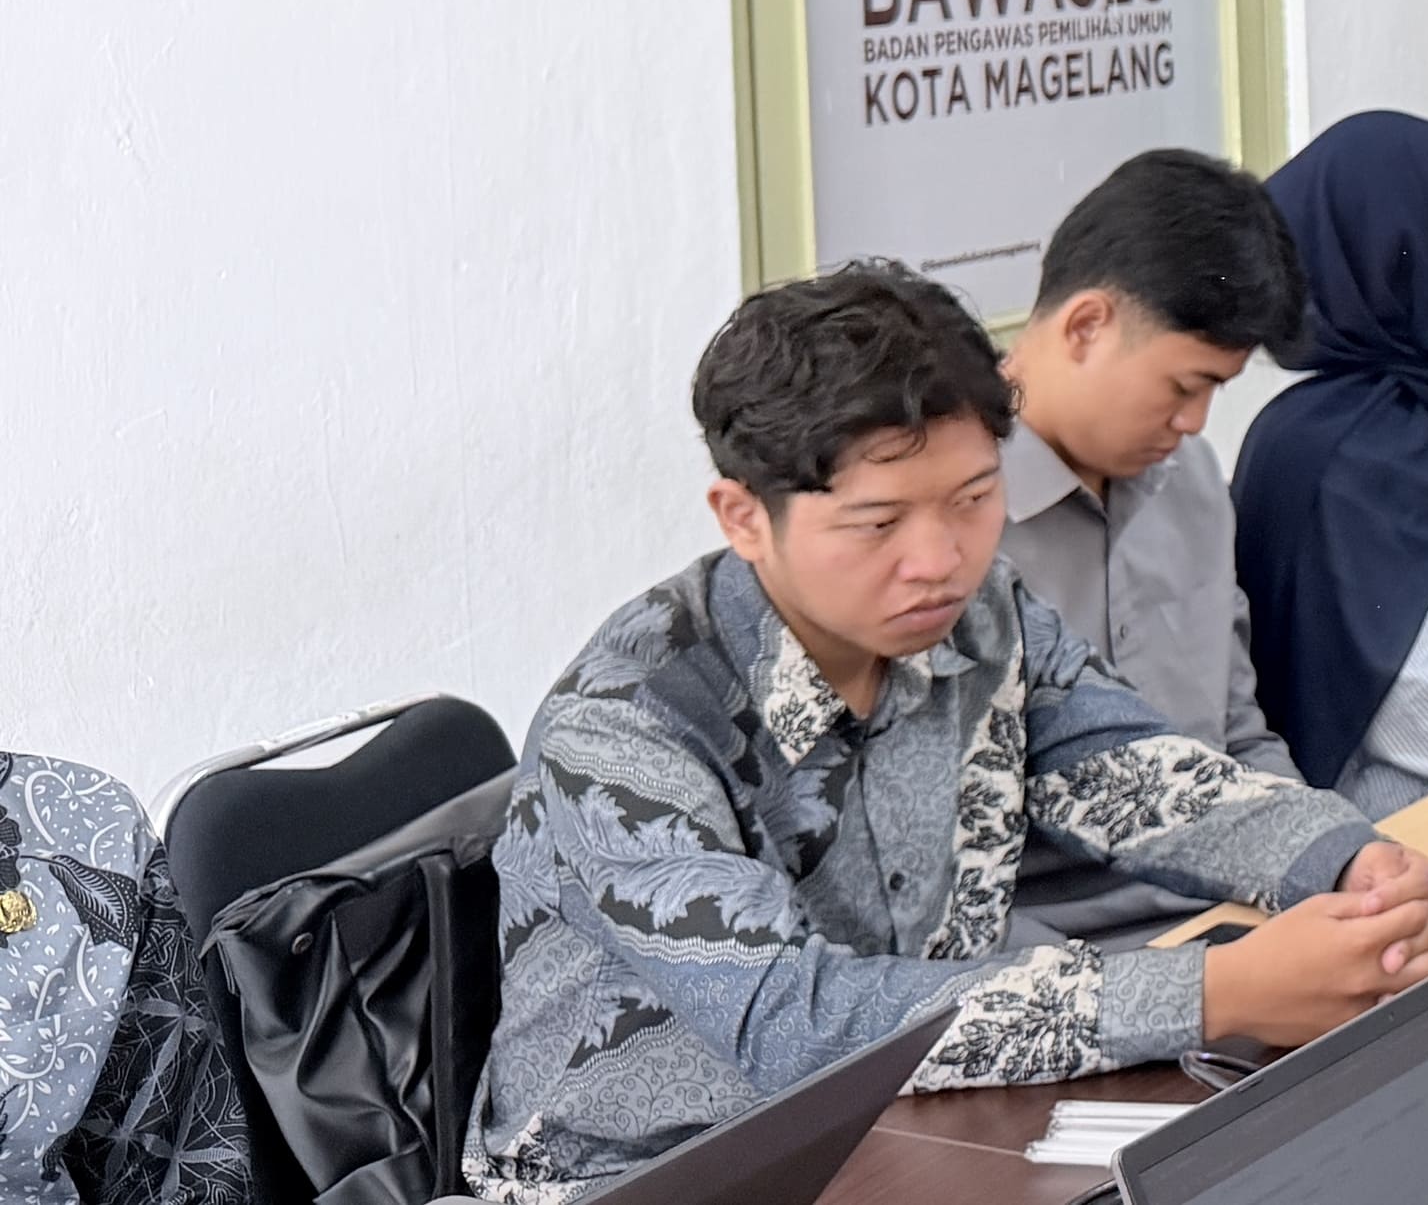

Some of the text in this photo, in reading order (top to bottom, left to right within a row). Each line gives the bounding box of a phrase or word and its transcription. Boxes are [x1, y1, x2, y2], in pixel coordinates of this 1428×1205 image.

[863, 10, 1173, 63] BADAN PENGAWAS PEMILIHAN UMUM
[864, 43, 1175, 127] KOTA MAGELANG
